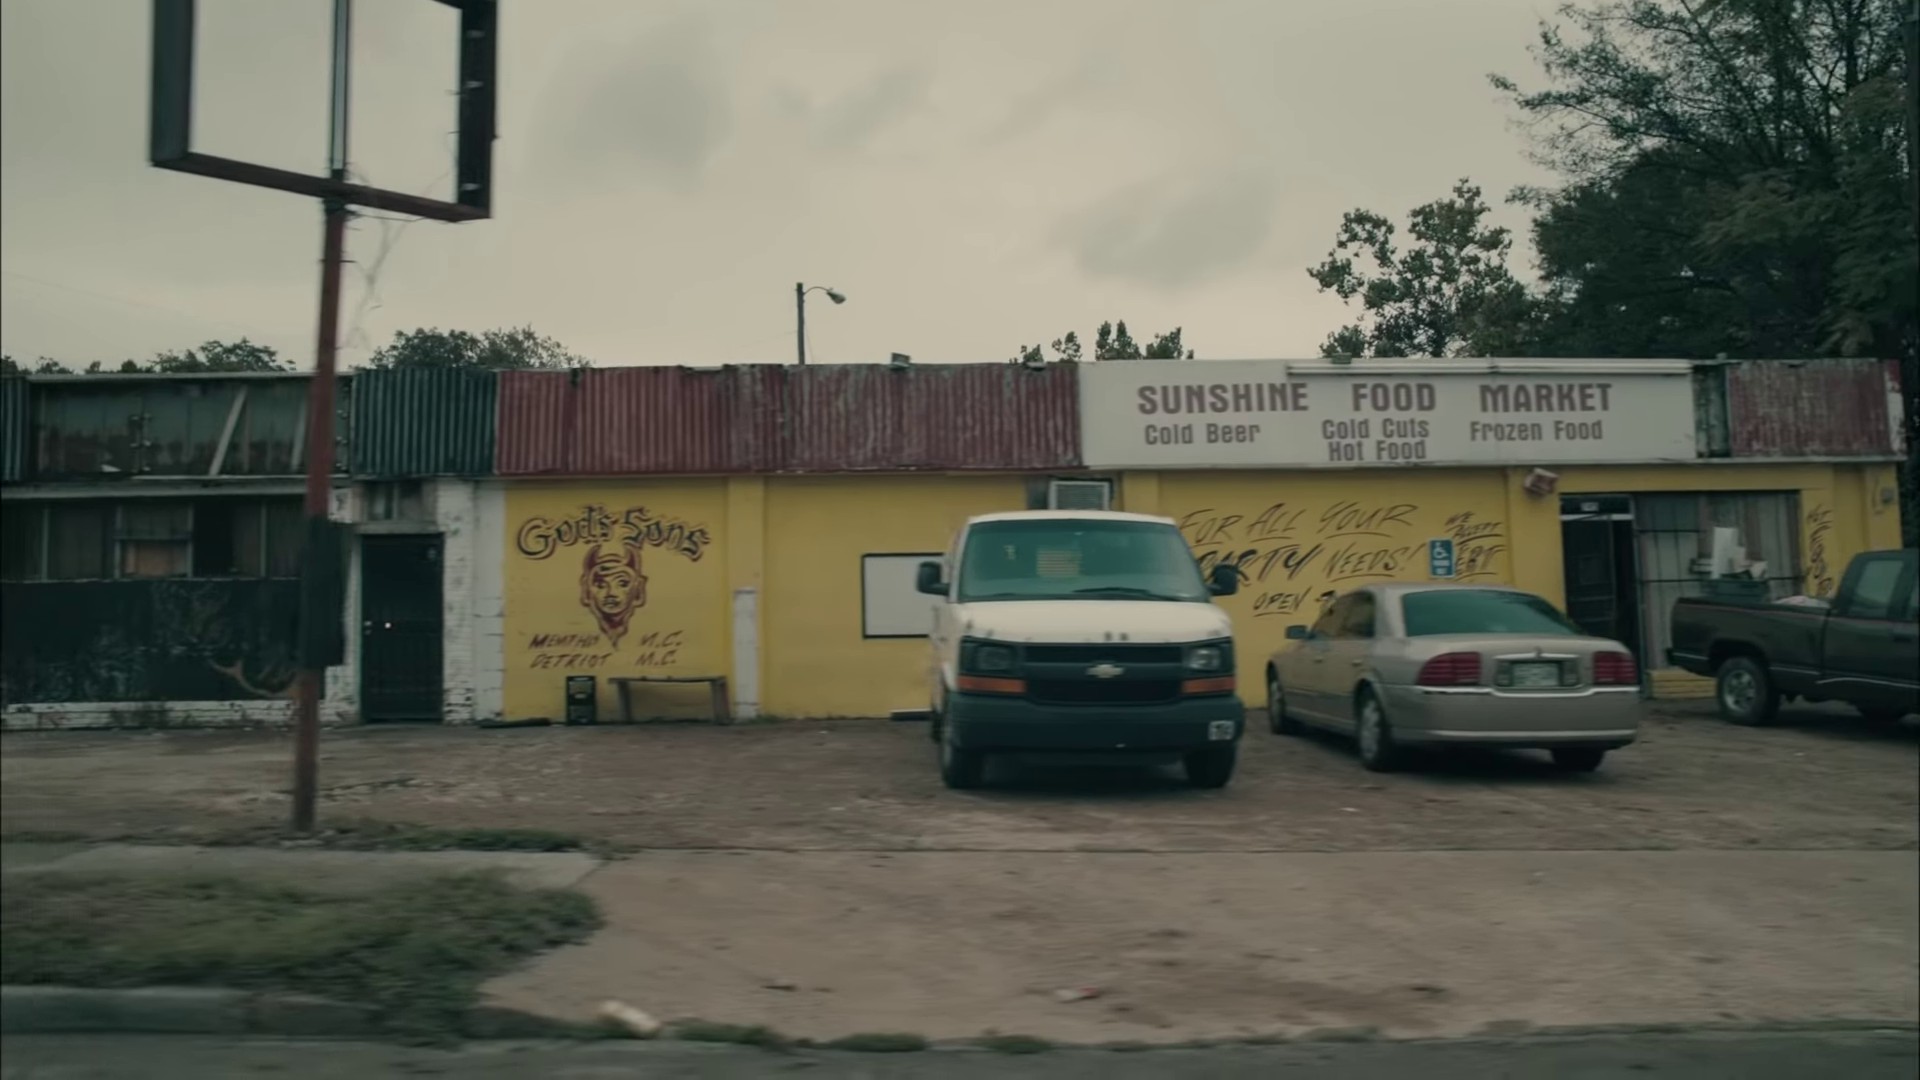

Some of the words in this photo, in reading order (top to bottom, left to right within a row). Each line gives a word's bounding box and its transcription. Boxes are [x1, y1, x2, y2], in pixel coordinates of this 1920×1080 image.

[1137, 382, 1309, 414] SUNSHINE
[1352, 383, 1436, 412] FOOD
[1479, 383, 1613, 413] MARKET
[1145, 424, 1194, 445] Cold
[1206, 423, 1260, 444] Beer
[1322, 419, 1370, 440] Cold
[1382, 418, 1429, 439] Cuts
[1470, 421, 1543, 441] Frozen
[1553, 420, 1603, 441] Food
[1328, 440, 1365, 461] Hot
[1376, 439, 1426, 460] Food
[1179, 508, 1243, 543] FOR
[1247, 503, 1306, 535] ALL
[1316, 501, 1418, 534] YOUR
[621, 506, 711, 562] Sons
[1253, 586, 1313, 611] OPEN
